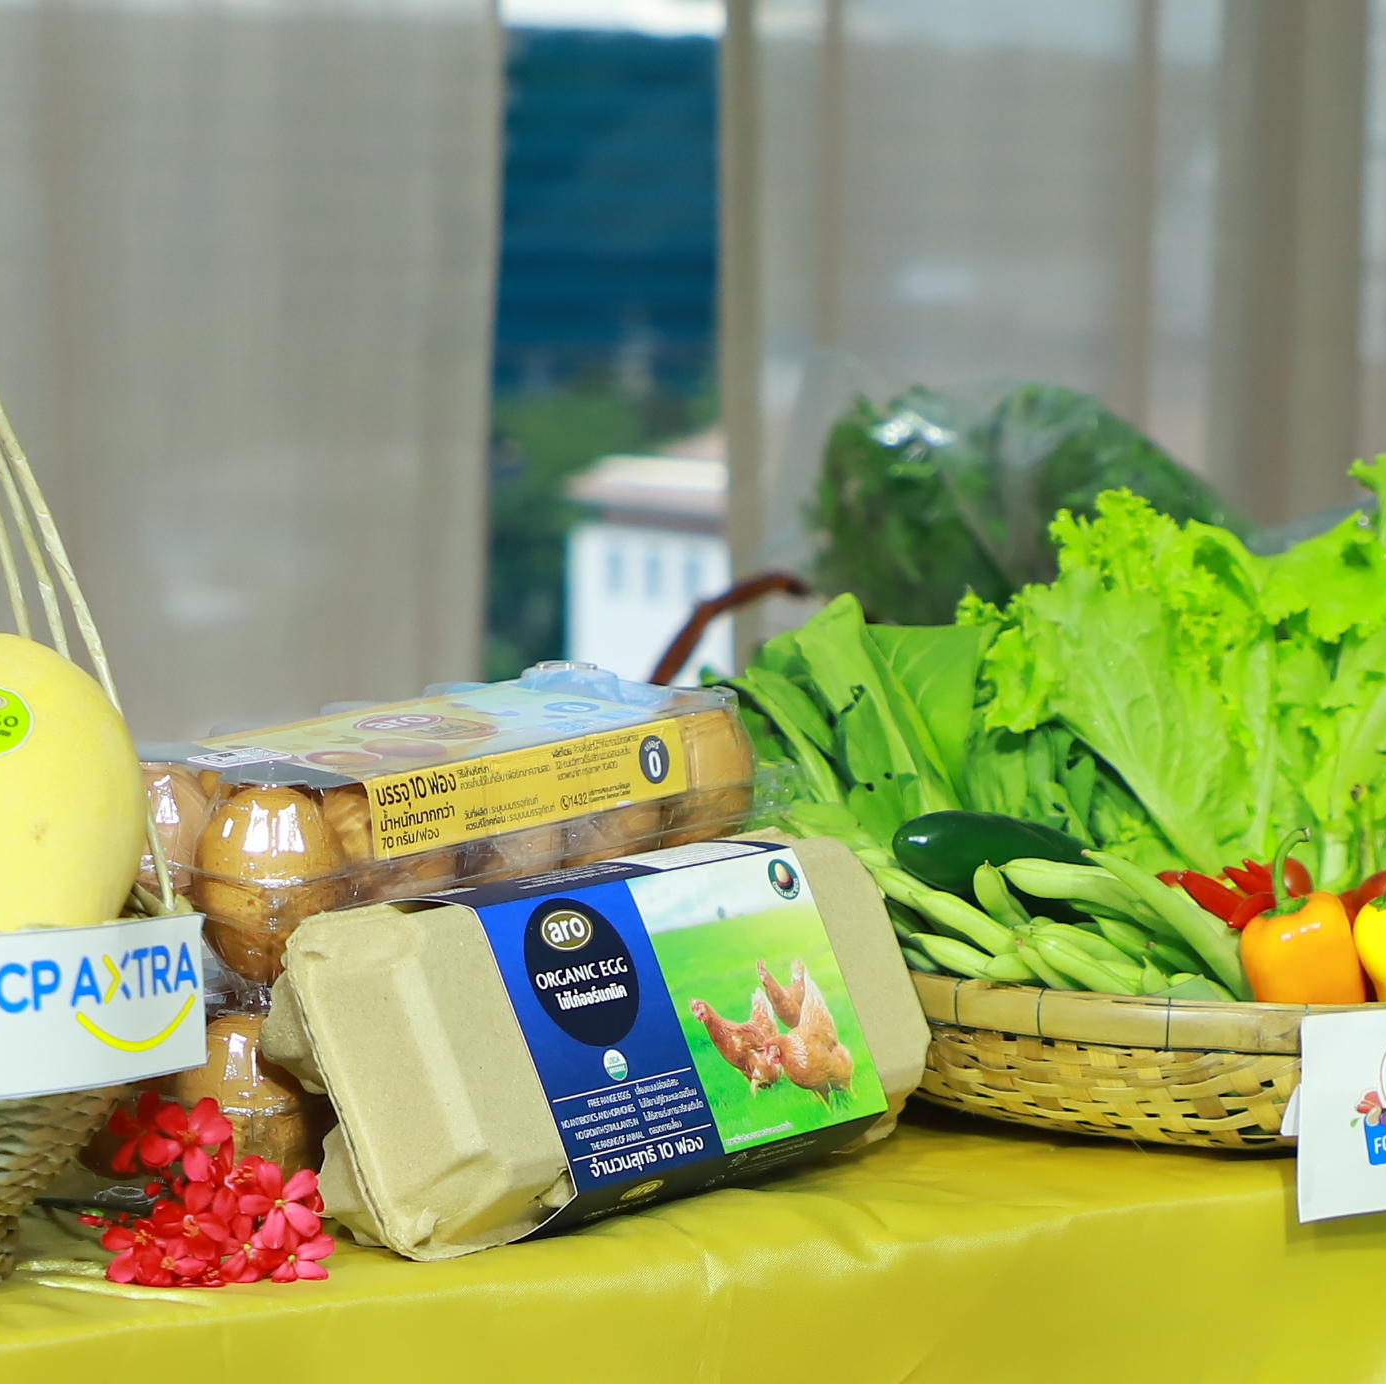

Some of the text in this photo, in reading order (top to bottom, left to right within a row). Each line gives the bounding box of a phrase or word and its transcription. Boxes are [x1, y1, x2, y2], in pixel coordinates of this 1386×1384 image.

[648, 751, 663, 778] 0
[376, 771, 457, 809] บรรจุ 10 ฟอง
[569, 792, 588, 806] 1432
[380, 801, 456, 832] น้ำหนักมากกว่า
[381, 827, 440, 850] 70 กรัม/ฟอง
[547, 916, 586, 944] aro
[69, 941, 199, 1008] AXTRA
[535, 956, 629, 990] ORGANIC EGG
[589, 1134, 705, 1178] จำนวนสุทธิ 10 ฟอง
